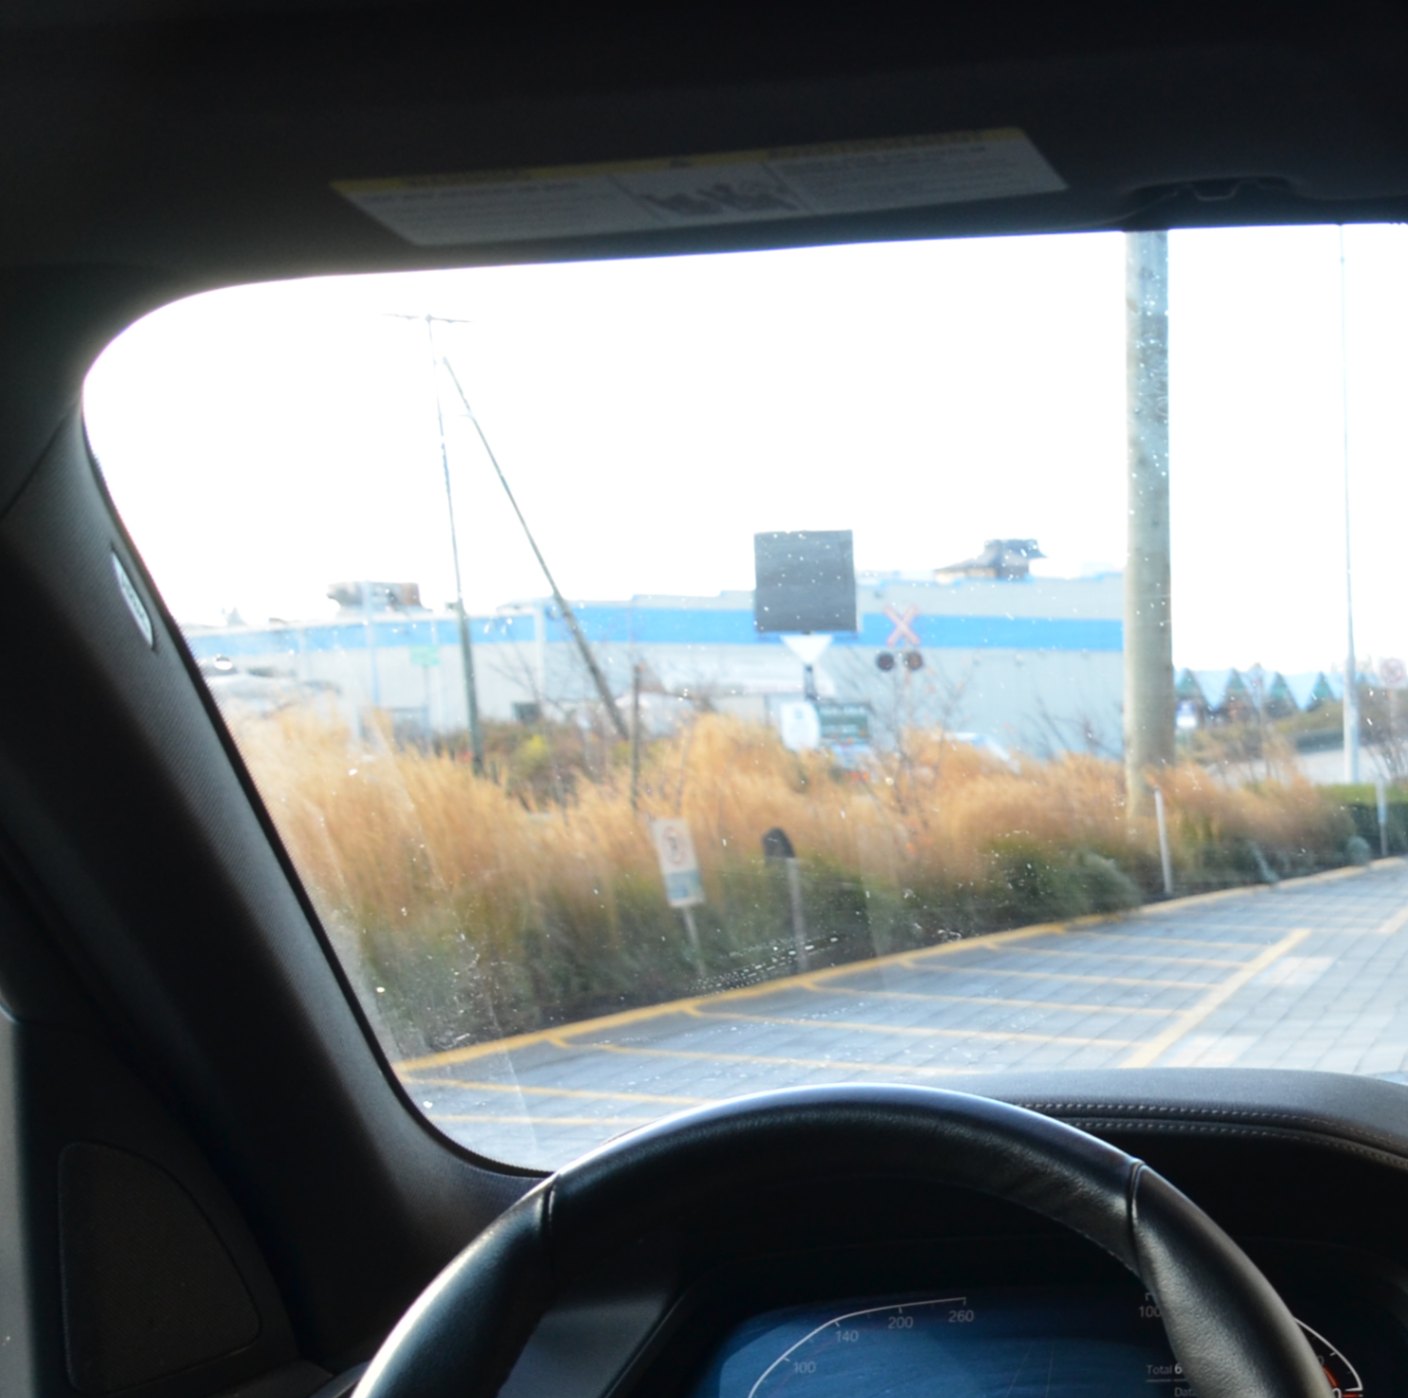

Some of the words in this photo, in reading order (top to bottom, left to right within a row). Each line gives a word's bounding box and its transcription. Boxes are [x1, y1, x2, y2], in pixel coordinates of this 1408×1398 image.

[888, 1316, 914, 1329] 200
[948, 1310, 974, 1323] 260
[836, 1331, 859, 1343] 140
[793, 1362, 816, 1374] 100
[1147, 1364, 1173, 1375] Total
